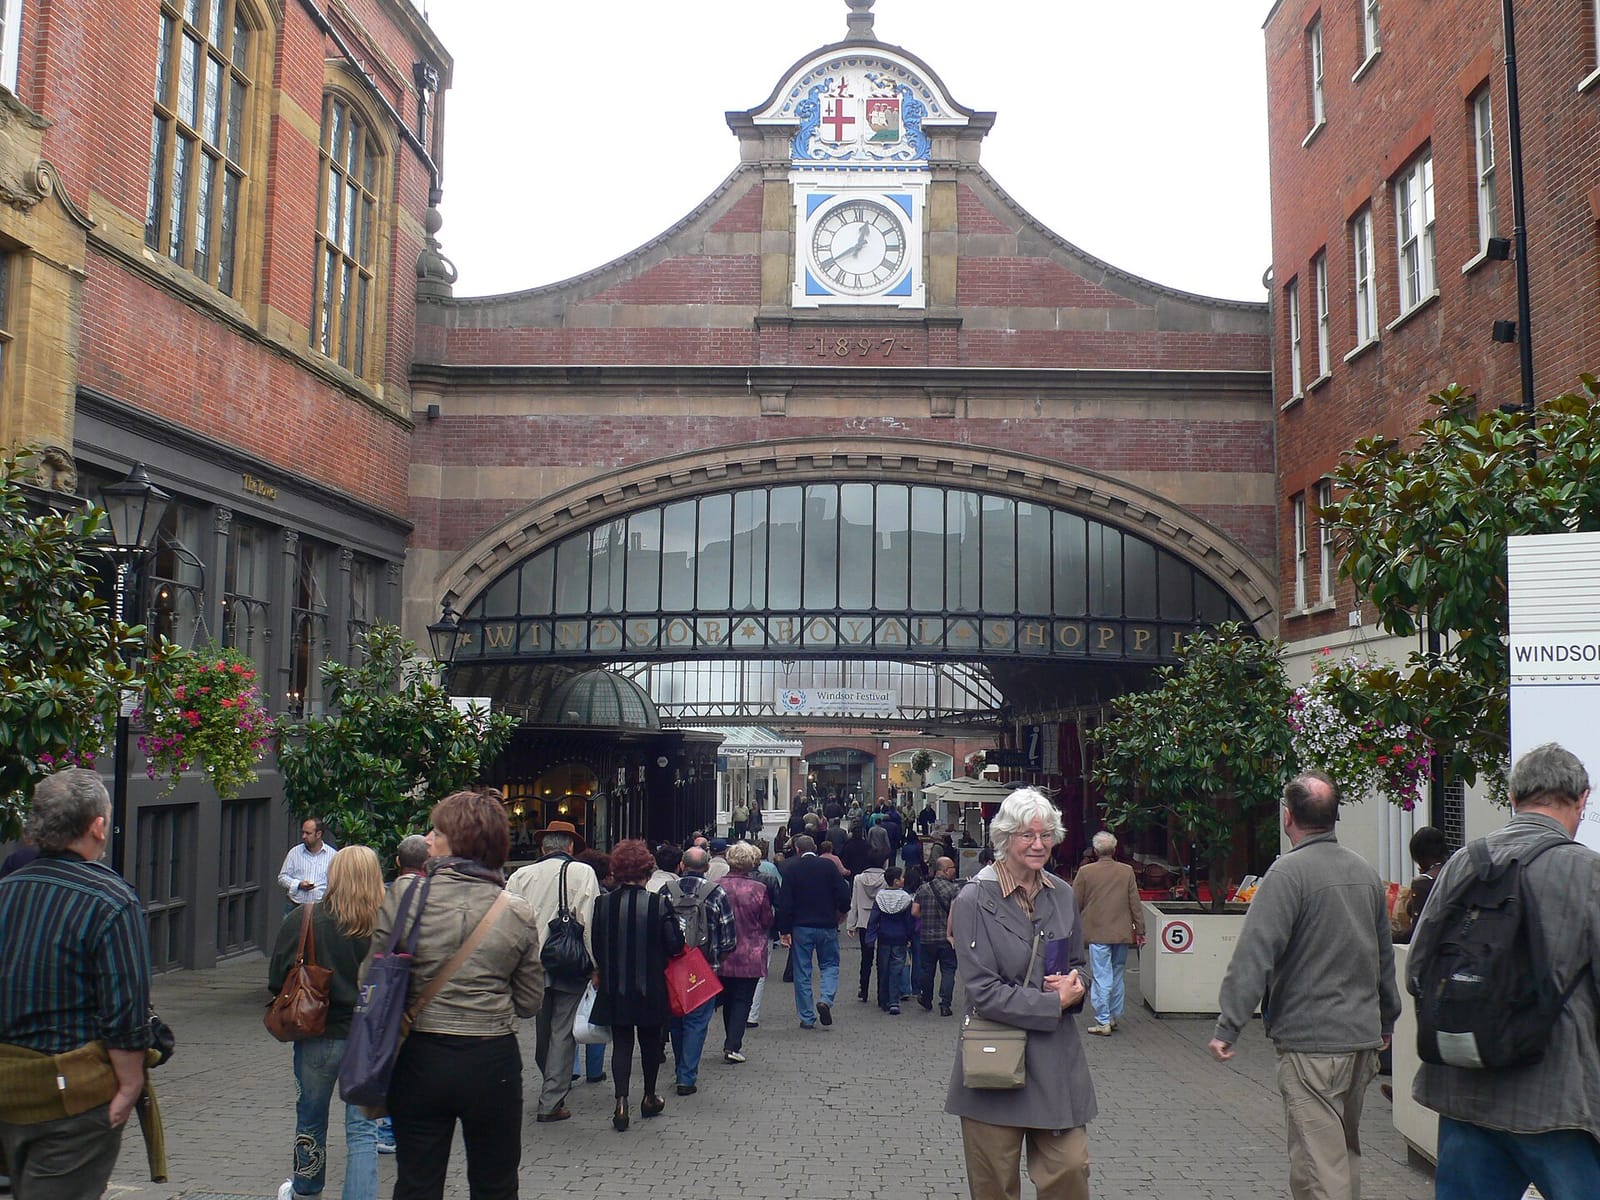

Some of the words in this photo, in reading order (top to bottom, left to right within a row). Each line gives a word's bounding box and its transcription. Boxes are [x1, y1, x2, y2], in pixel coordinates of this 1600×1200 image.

[113, 563, 129, 622] wagama
[484, 621, 722, 648] WINDSOR
[775, 618, 938, 643] ROYAL
[991, 623, 1182, 652] SHOPPI
[1514, 644, 1600, 662] WINDSO
[817, 691, 853, 701] Windsor
[856, 692, 890, 701] Festival
[1171, 929, 1184, 945] 5
